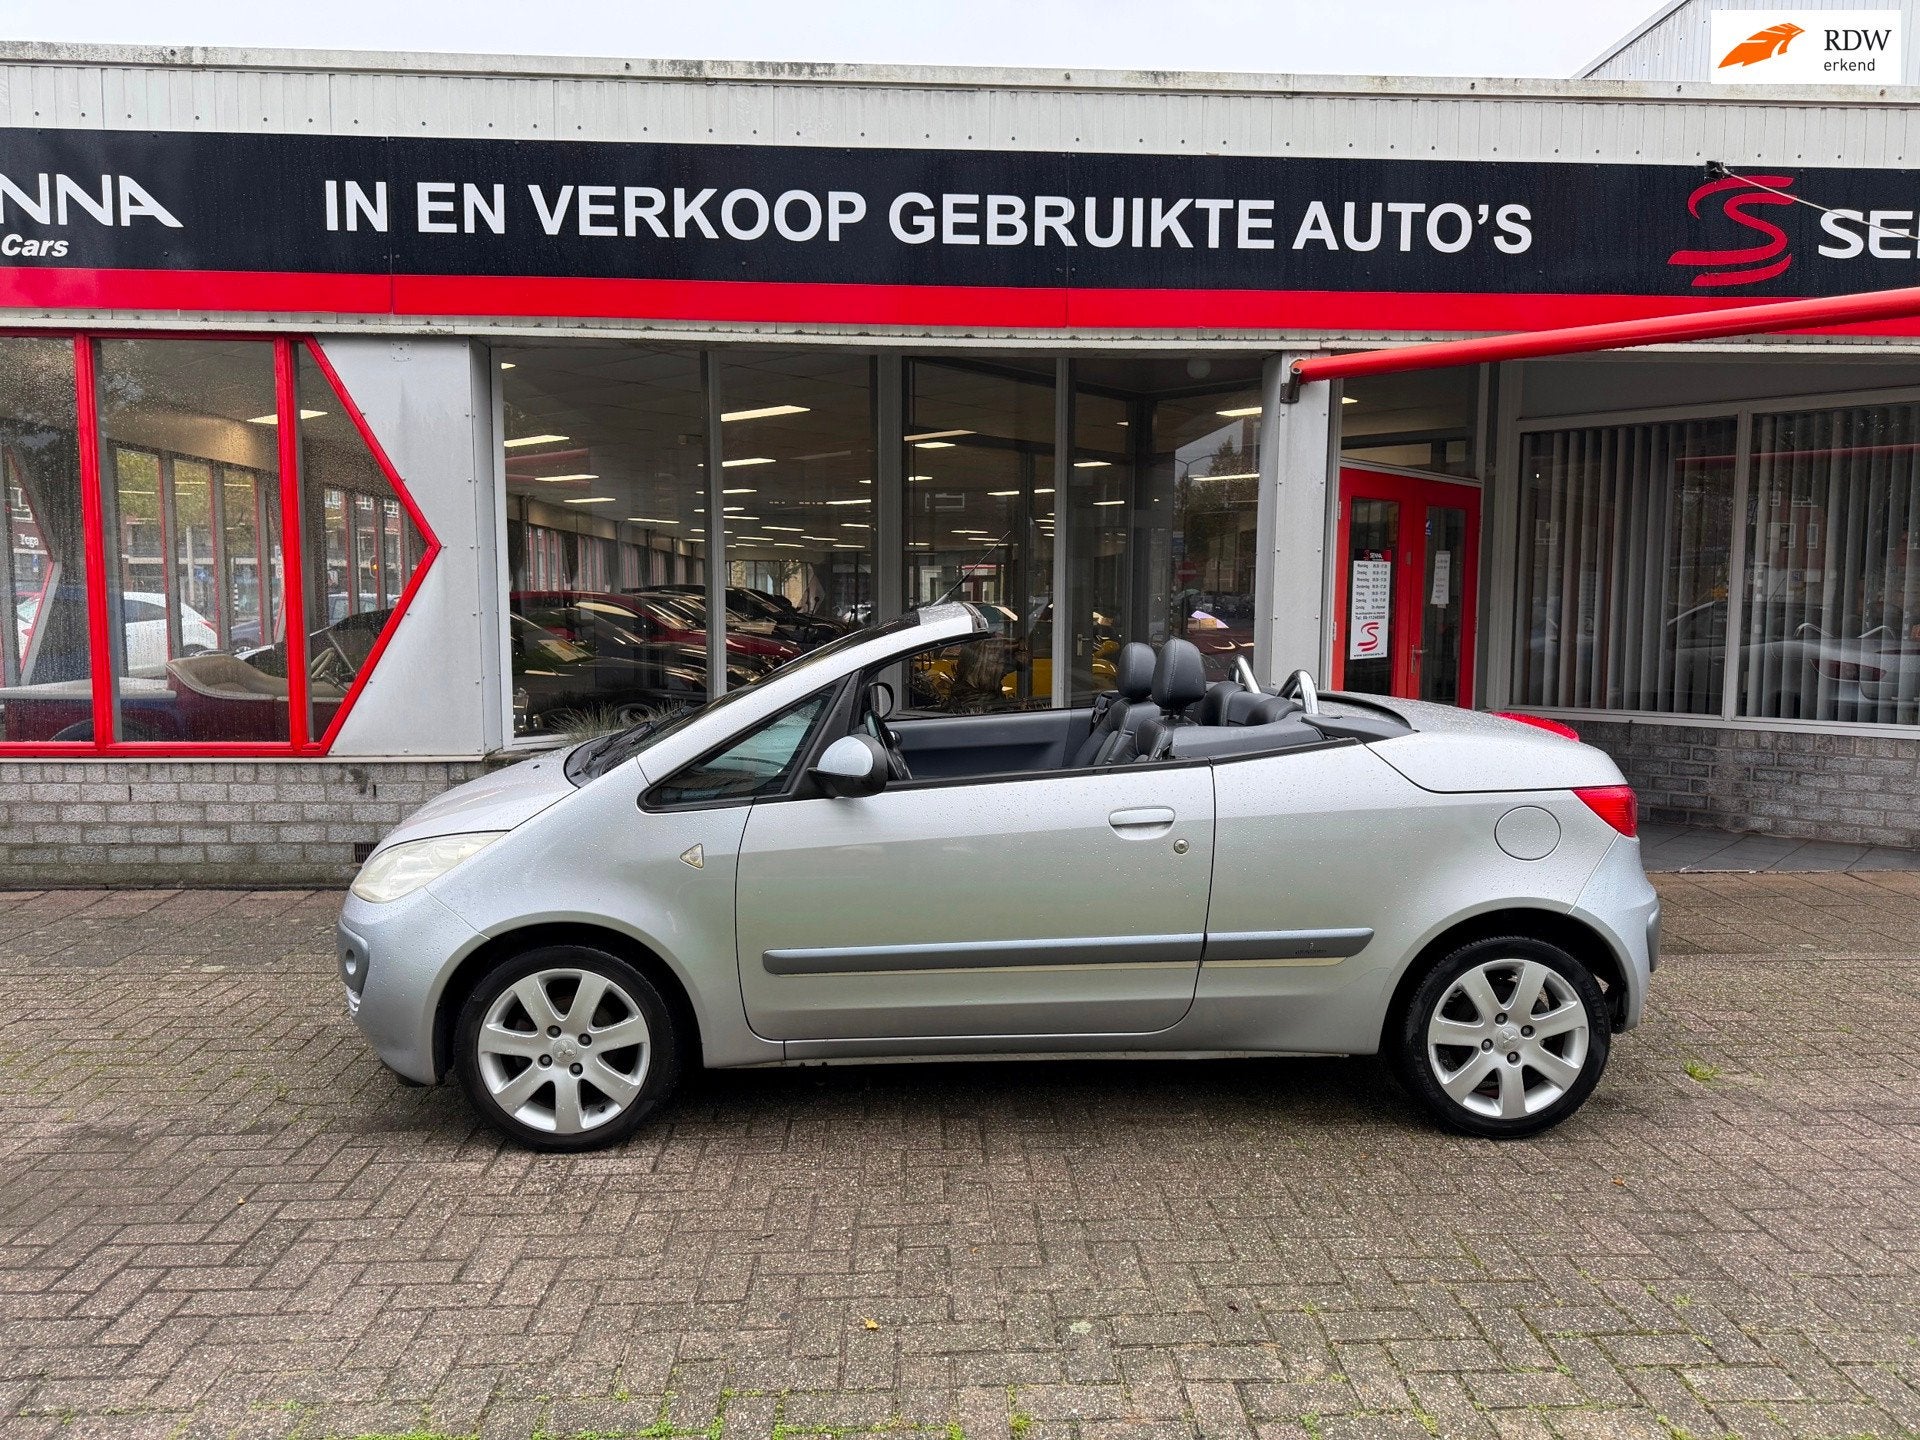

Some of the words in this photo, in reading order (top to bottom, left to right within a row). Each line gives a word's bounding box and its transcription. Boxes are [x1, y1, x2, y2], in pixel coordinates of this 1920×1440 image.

[325, 180, 388, 232] IN
[416, 181, 505, 234] EN
[527, 184, 867, 242] VERKOOP
[888, 191, 1275, 250] GEBRUIKTE
[1291, 200, 1533, 254] AUTO’S
[1817, 208, 1920, 260] SE
[1, 233, 69, 258] Cars
